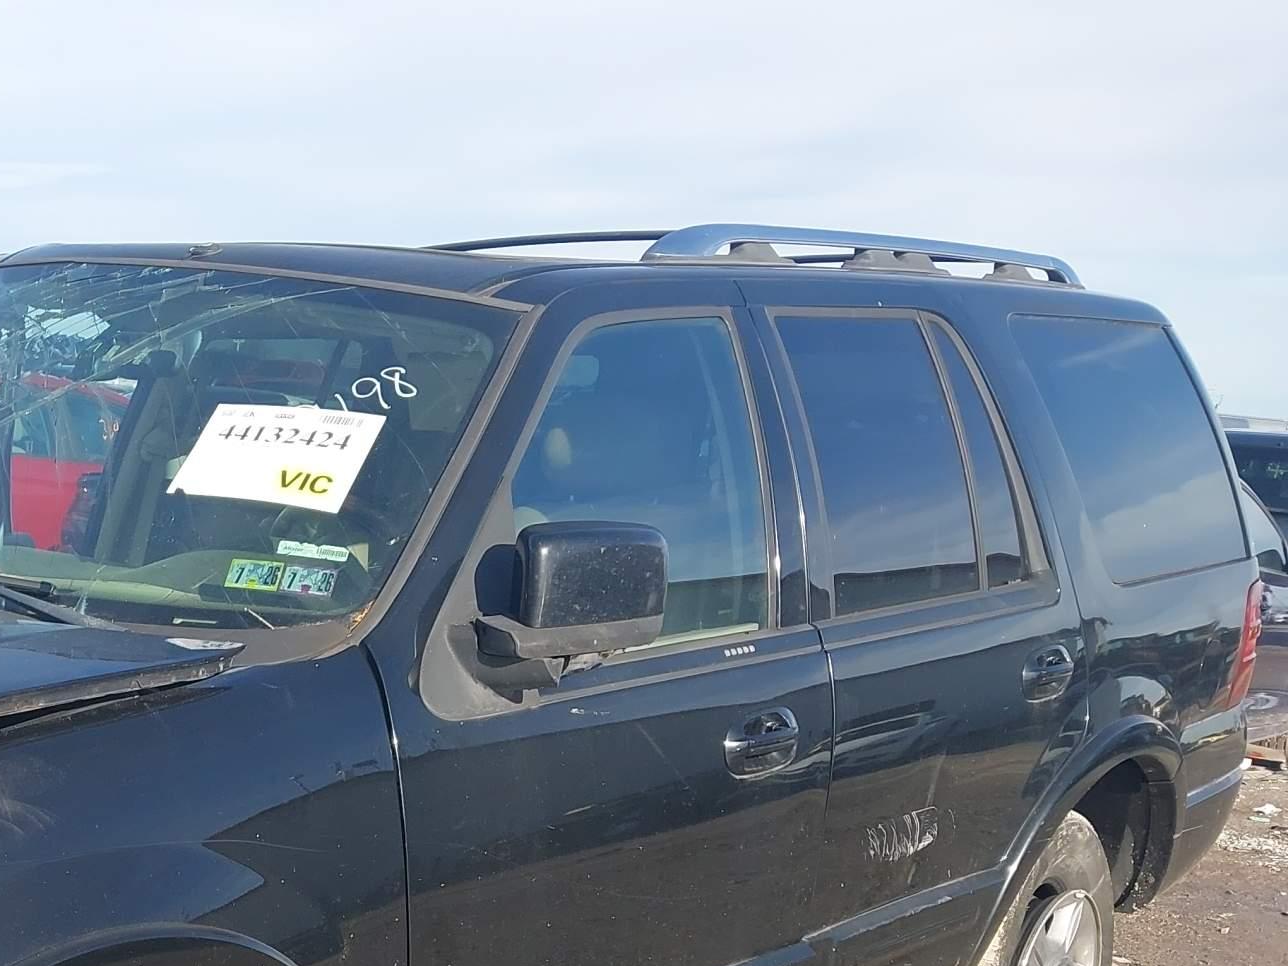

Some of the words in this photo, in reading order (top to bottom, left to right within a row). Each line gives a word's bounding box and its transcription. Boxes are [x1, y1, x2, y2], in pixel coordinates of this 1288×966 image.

[299, 366, 418, 411] 198
[218, 424, 352, 450] 44132424
[280, 470, 333, 494] VIC
[234, 567, 245, 584] 7
[263, 566, 281, 586] 26
[287, 572, 297, 589] 7
[317, 571, 334, 592] 26
